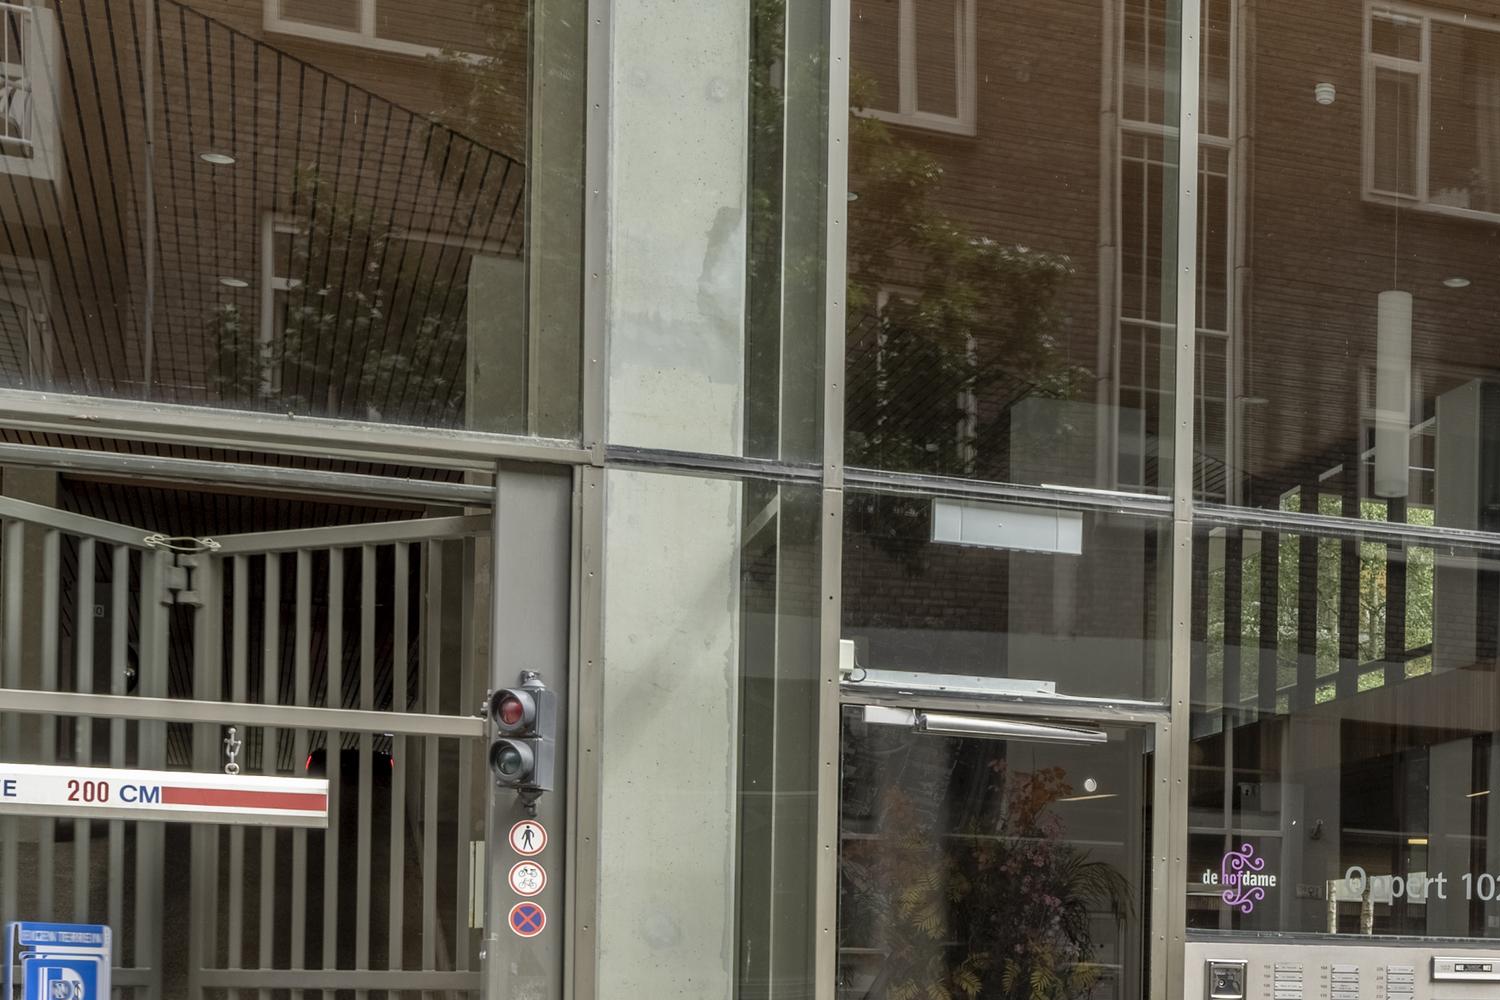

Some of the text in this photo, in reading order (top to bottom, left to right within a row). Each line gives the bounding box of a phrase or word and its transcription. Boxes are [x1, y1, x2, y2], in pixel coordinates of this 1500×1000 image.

[67, 779, 109, 803] 200
[119, 784, 160, 804] CM
[1202, 869, 1277, 888] de hofdame
[1344, 865, 1448, 906] Oppert
